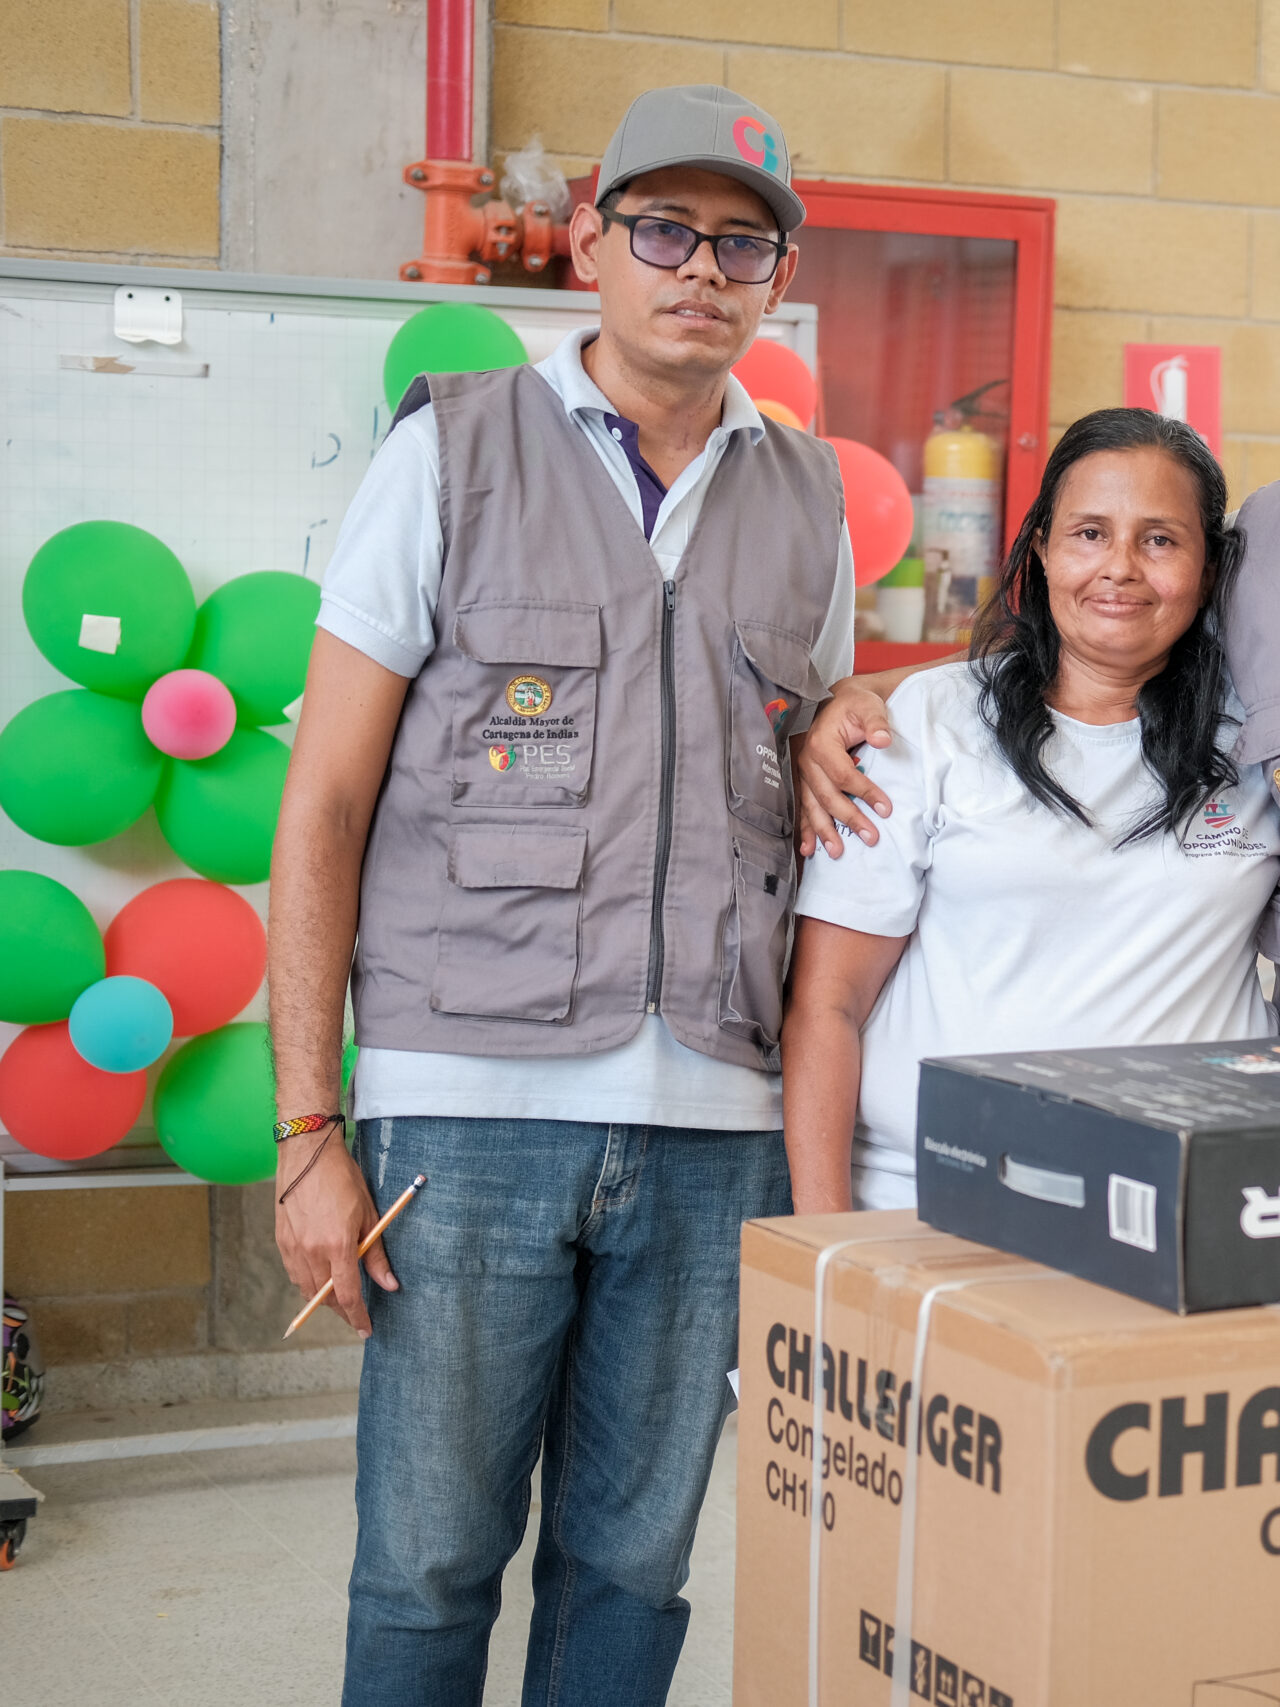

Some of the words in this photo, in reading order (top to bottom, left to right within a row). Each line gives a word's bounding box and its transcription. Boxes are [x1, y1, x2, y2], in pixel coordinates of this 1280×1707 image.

[529, 717, 560, 728] Mayor
[562, 715, 575, 726] de
[482, 729, 532, 741] Cartagena
[533, 729, 546, 739] de
[547, 729, 579, 740] Indias
[523, 744, 572, 765] PES
[1196, 827, 1241, 840] CAMINO
[1183, 839, 1267, 850] OPORTUNIDADES
[766, 1322, 1003, 1495] CHALLENGER
[766, 1397, 903, 1506] Congelado
[766, 1460, 836, 1532] CH10
